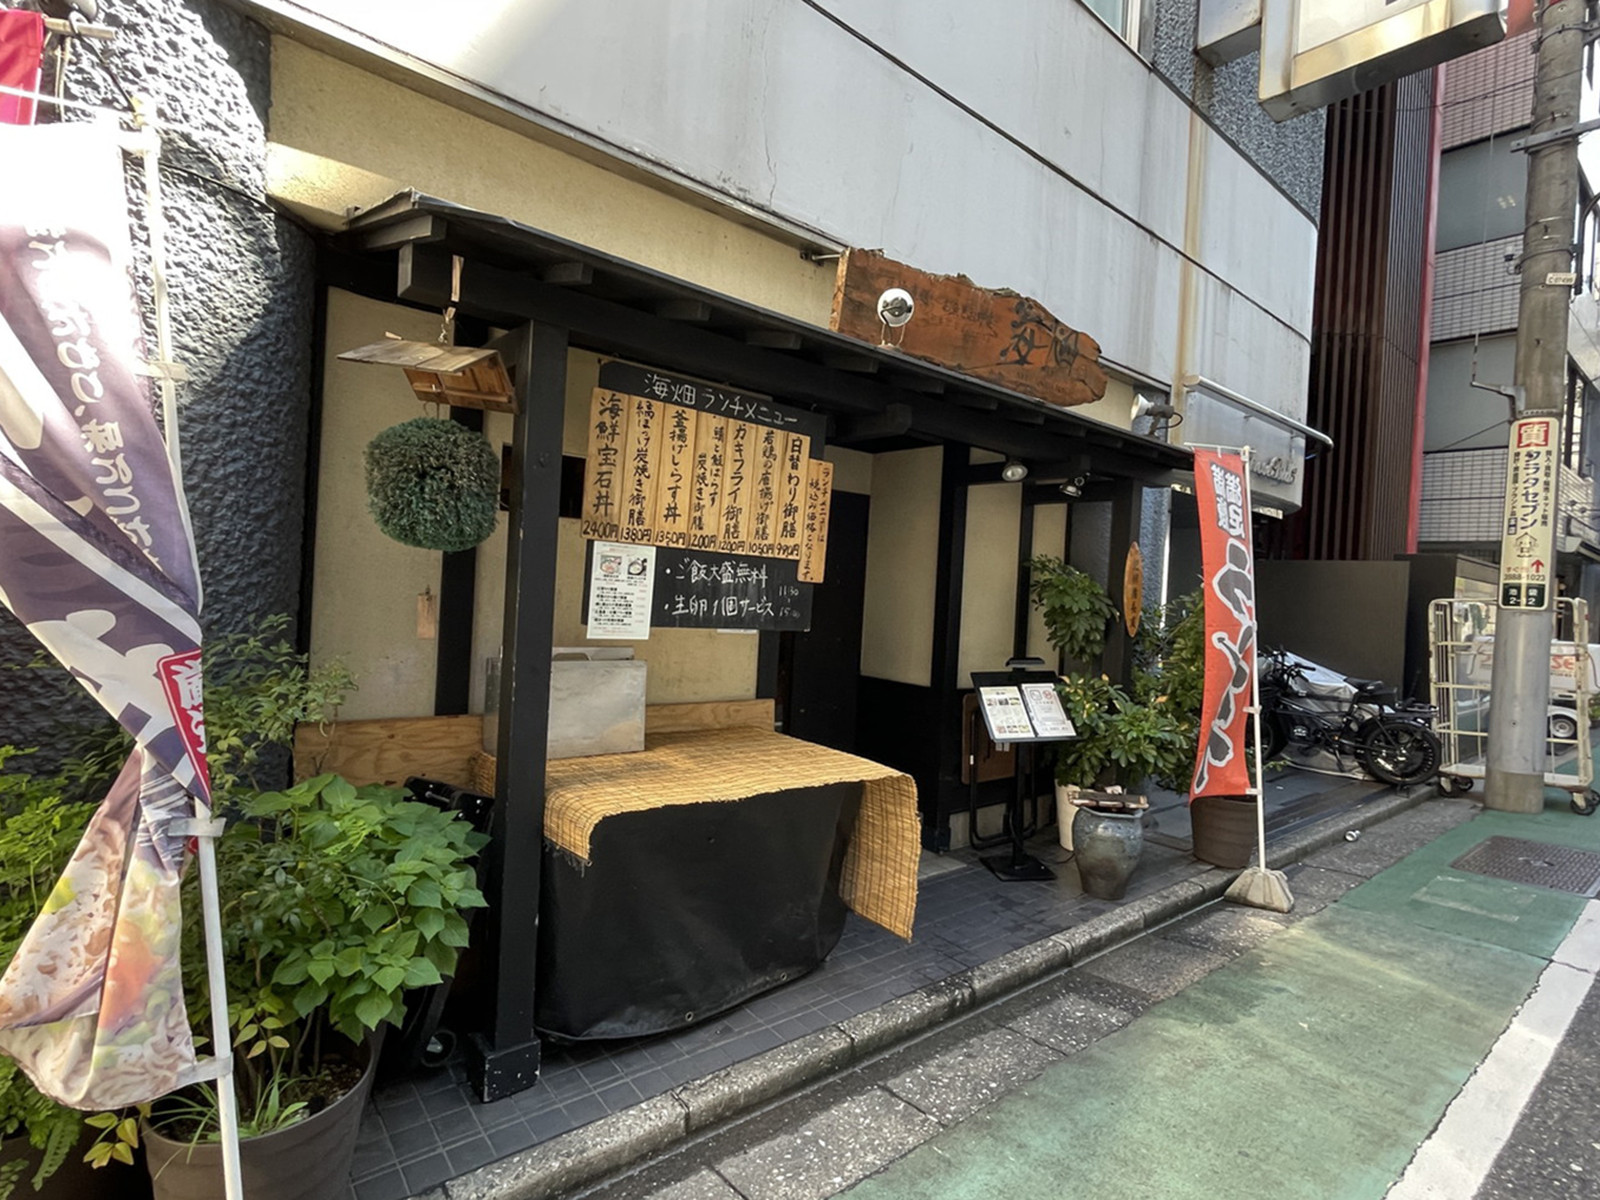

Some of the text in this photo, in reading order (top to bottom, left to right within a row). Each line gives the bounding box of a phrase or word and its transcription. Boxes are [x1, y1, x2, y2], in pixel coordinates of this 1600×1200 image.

[644, 373, 798, 425] 海畑 ランチメニュー
[593, 393, 624, 517] 海鮮宝石丼
[662, 409, 689, 525] 釜揚げしらす丼
[781, 437, 803, 539] 日替わり御膳
[583, 520, 618, 539] 2400円
[620, 527, 652, 543] 1380円
[655, 530, 686, 547] 1350円
[748, 542, 775, 556] 1050円
